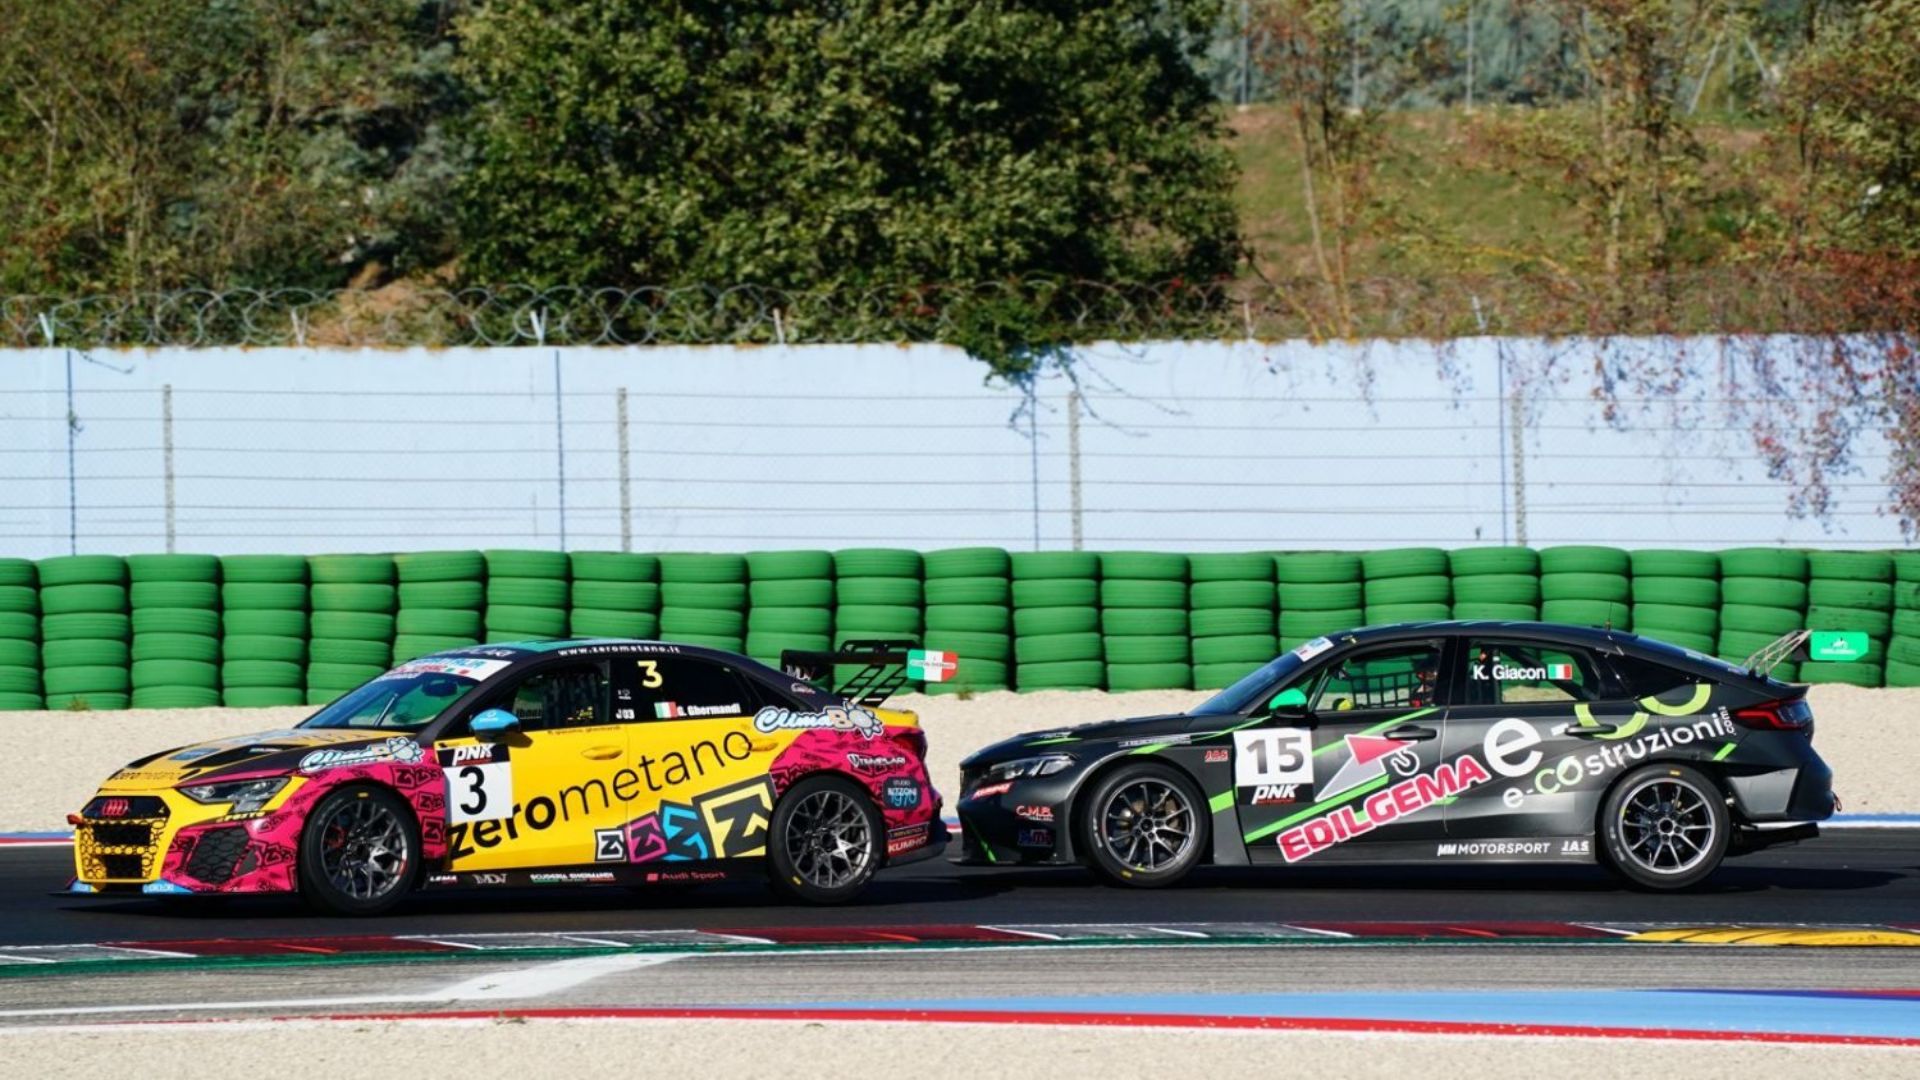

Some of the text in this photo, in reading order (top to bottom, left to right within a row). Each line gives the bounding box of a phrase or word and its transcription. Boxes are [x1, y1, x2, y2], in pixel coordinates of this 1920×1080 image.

[637, 660, 663, 688] 3
[1473, 664, 1546, 680] K. Giacon
[1246, 737, 1304, 774] 15
[446, 731, 753, 861] zerometano
[459, 766, 487, 815] 3
[1277, 755, 1491, 863] EDILGEMA
[1458, 842, 1551, 855] MOTORSPORT
[1561, 840, 1590, 853] JAS
[662, 871, 726, 881] Audi Sport
